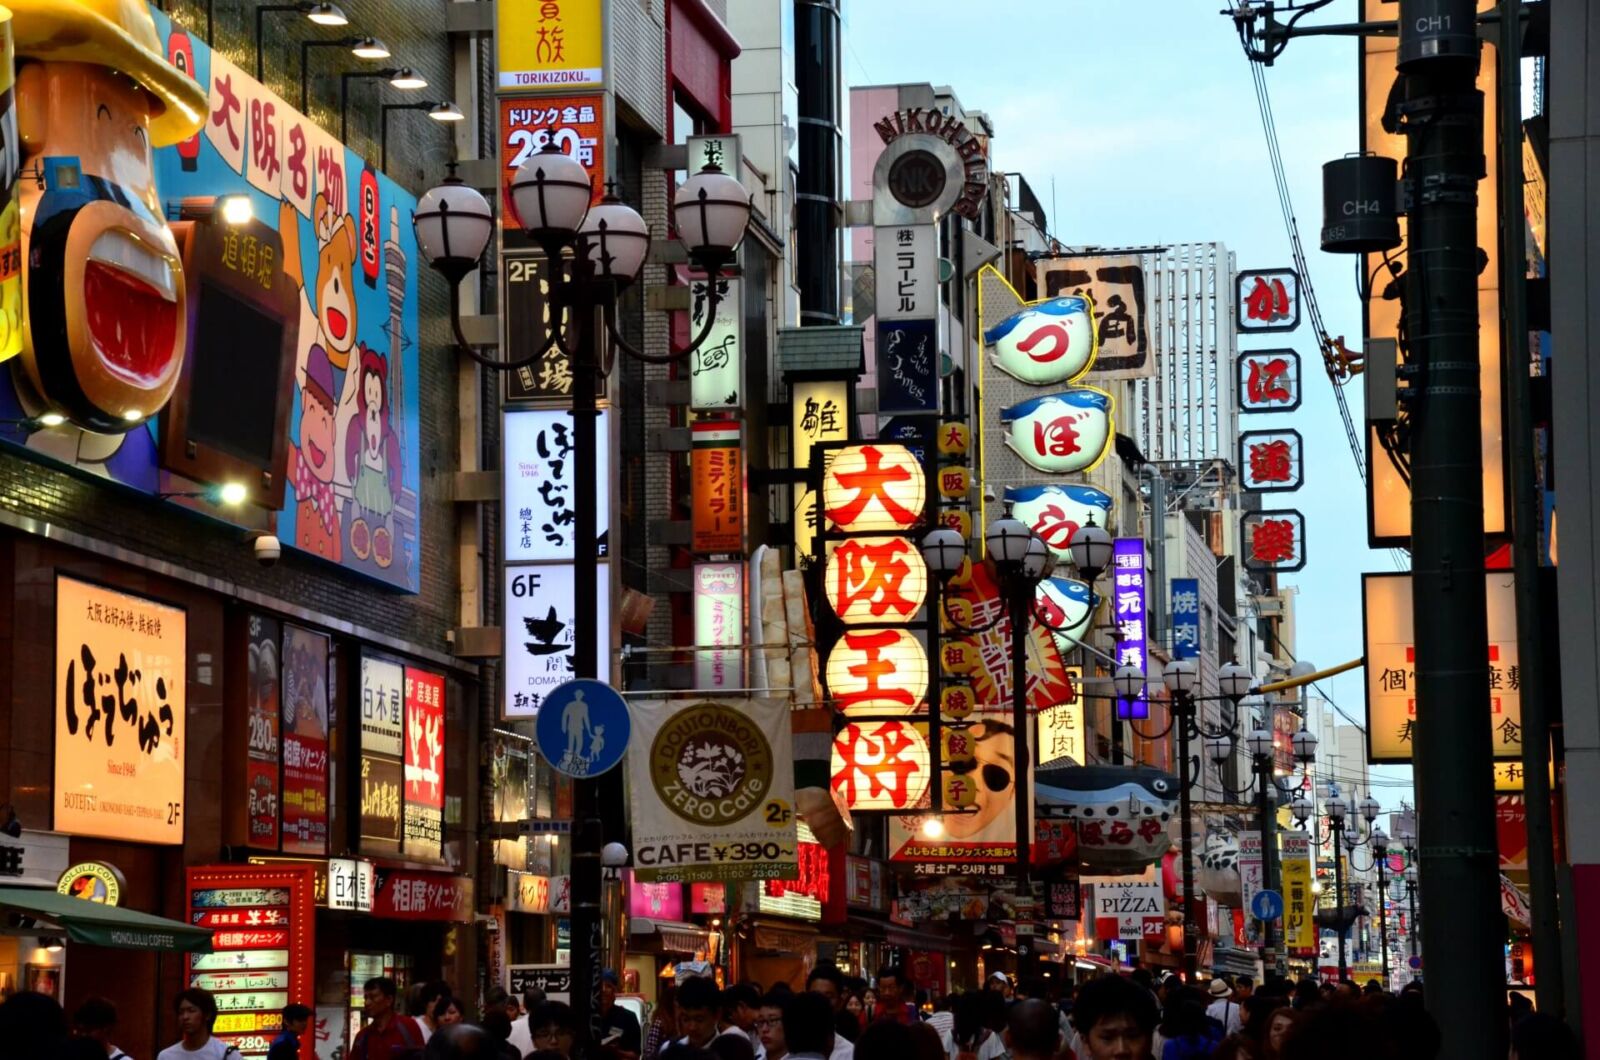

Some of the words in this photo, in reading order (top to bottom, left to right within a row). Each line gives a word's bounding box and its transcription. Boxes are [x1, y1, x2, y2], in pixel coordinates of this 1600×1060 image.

[1415, 16, 1452, 32] CH1
[515, 71, 583, 84] TORIKIZOKU
[509, 107, 559, 126] ドリンク
[561, 106, 595, 124] 全品
[212, 74, 344, 217] 大阪名物
[1342, 200, 1381, 216] CH4
[509, 261, 537, 282] 2F
[692, 334, 737, 377] Leaf
[890, 354, 927, 405] James
[518, 462, 539, 470] Since
[511, 574, 541, 598] 6F
[824, 445, 921, 809] 大阪王将
[1172, 590, 1198, 646] 焼肉
[657, 712, 763, 761] DOUTONBORI
[662, 780, 716, 820] ZERO
[717, 778, 764, 819] Cafe
[167, 802, 181, 825] 2F
[765, 802, 791, 823] 2F
[637, 842, 711, 866] CAFE
[1102, 897, 1160, 913] PIZZA
[110, 931, 148, 946] HONOLULU
[1144, 922, 1164, 935] 2F
